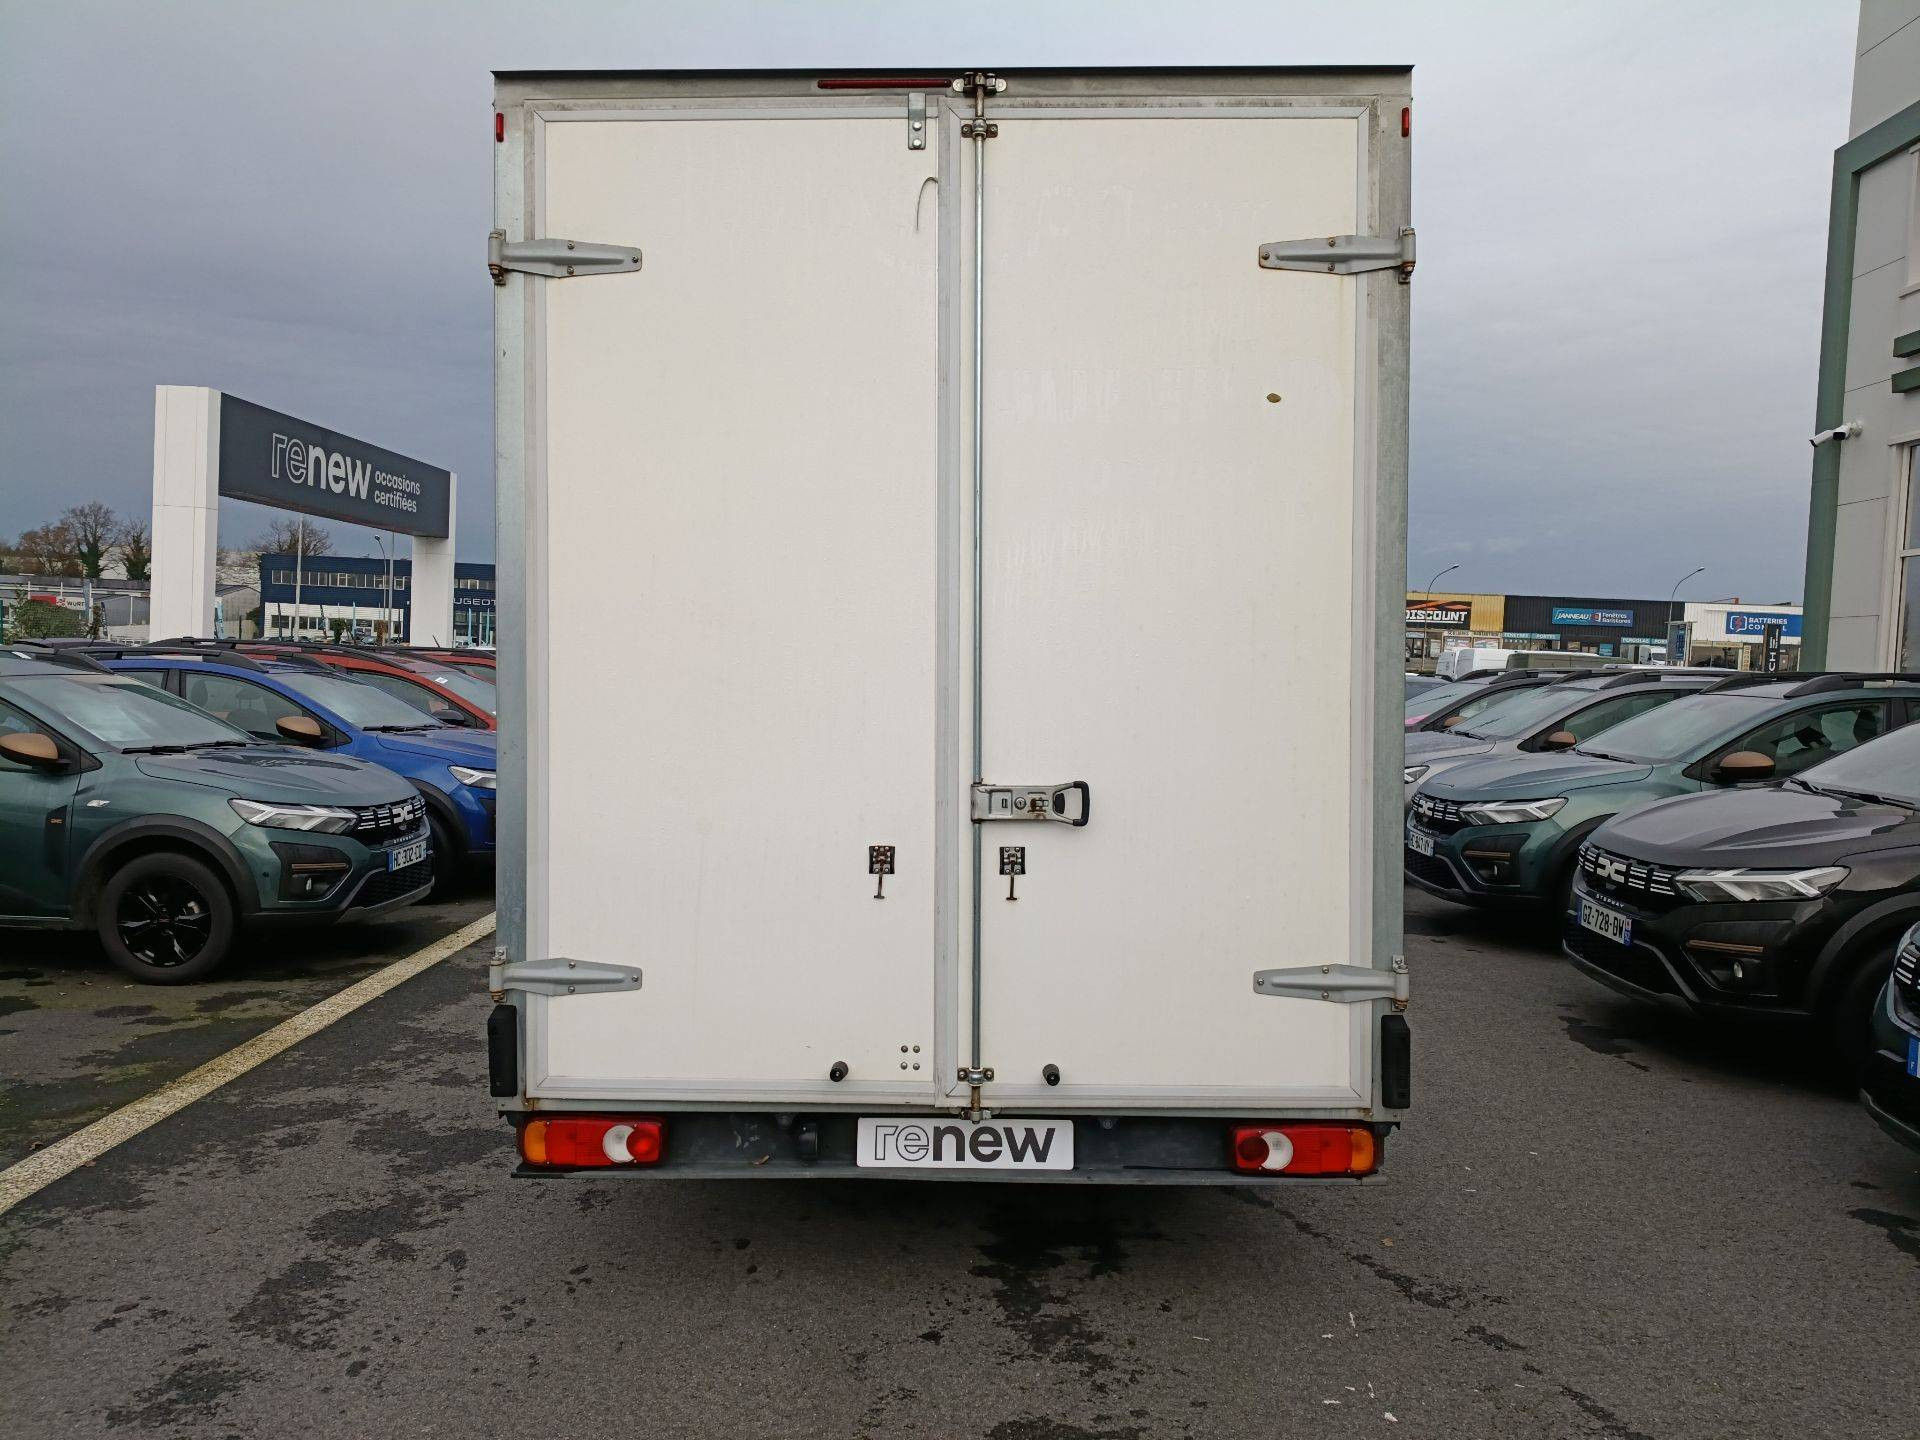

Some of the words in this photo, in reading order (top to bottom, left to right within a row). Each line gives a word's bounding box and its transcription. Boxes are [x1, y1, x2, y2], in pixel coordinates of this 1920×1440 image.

[271, 432, 372, 500] renew
[375, 470, 421, 496] occasions
[374, 489, 417, 513] certifiées
[453, 598, 496, 606] UGEOT
[1557, 612, 1590, 620] JANNEAU
[1748, 617, 1788, 625] BATTERIES
[874, 1124, 1057, 1163] renew
